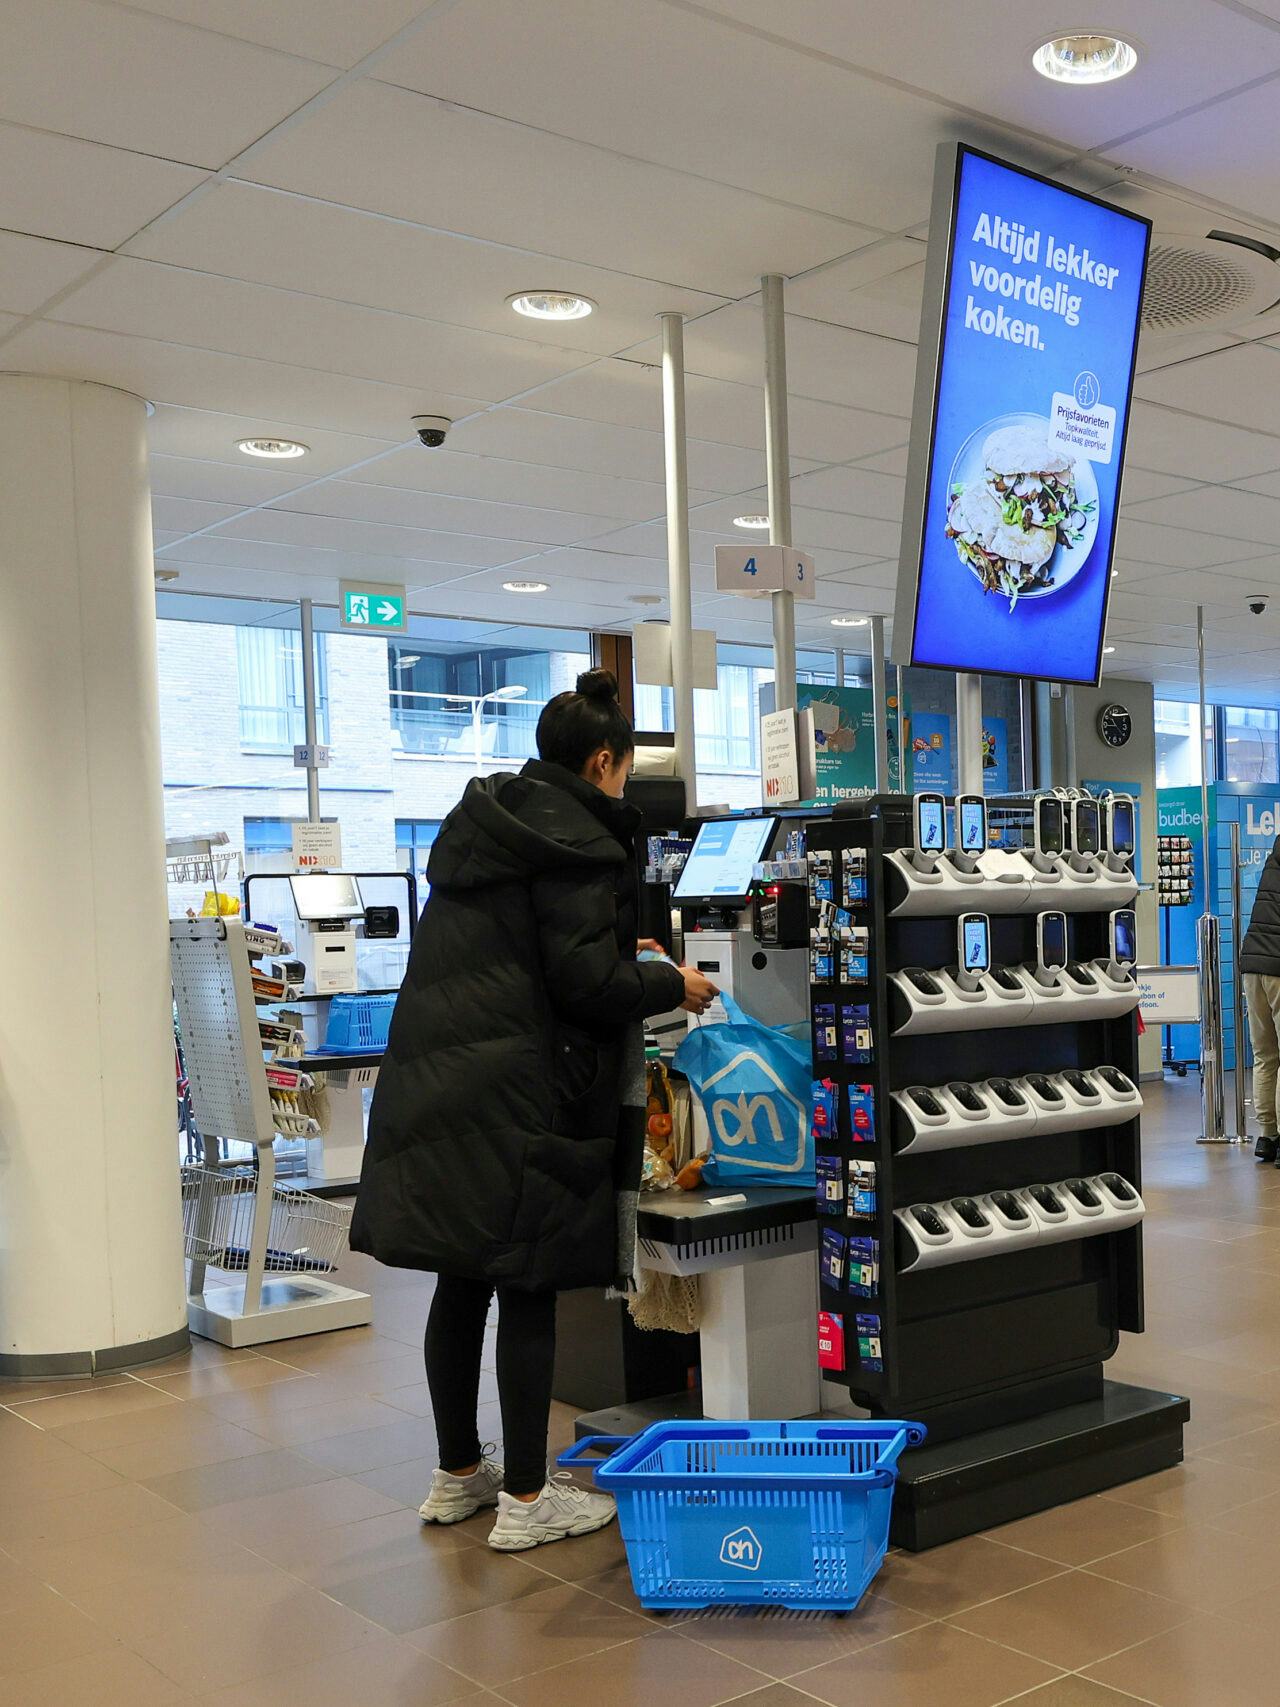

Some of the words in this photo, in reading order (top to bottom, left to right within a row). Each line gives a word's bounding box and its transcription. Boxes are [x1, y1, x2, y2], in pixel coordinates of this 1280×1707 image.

[972, 213, 1040, 264] Altijd
[1046, 236, 1119, 290] lekker
[968, 260, 1082, 326] voordelig
[964, 295, 1045, 351] koken.
[1057, 406, 1110, 429] Prijsfavorieten
[743, 557, 757, 576] 4
[797, 563, 804, 581] 3
[299, 750, 309, 760] 12
[1158, 808, 1209, 827] budbe
